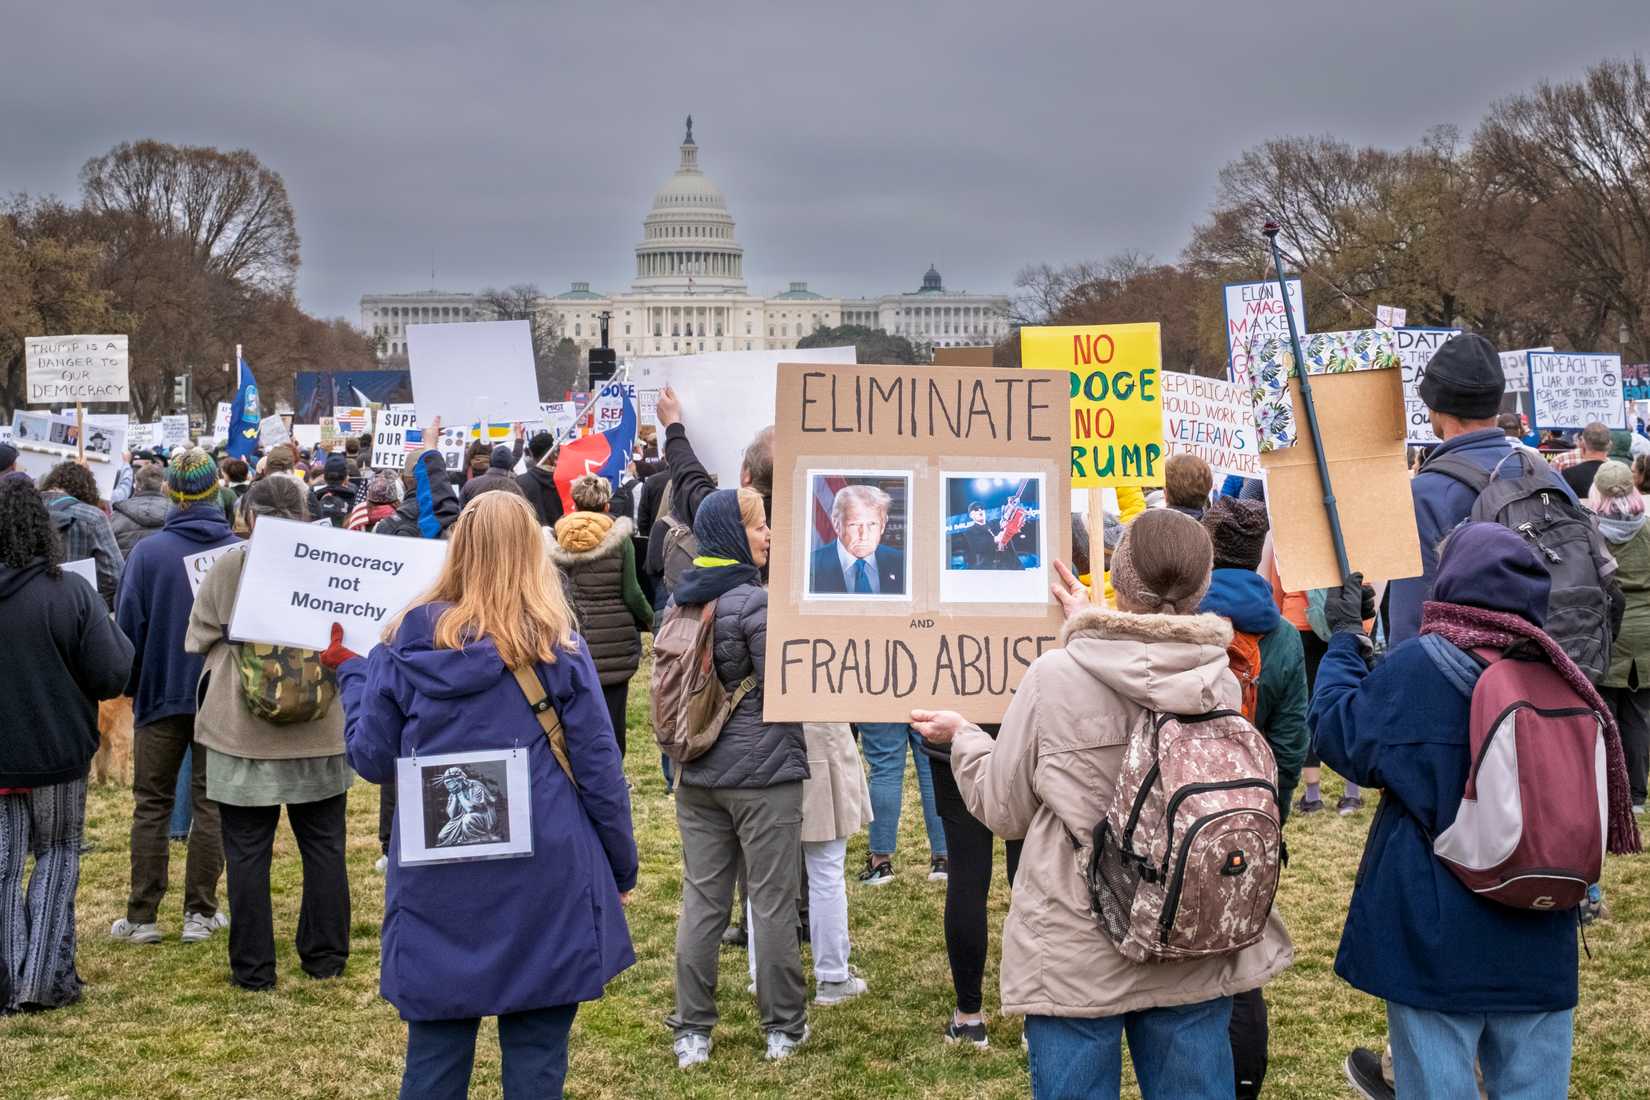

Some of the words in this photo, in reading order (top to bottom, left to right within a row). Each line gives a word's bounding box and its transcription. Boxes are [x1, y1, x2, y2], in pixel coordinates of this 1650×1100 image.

[1242, 285, 1274, 302] ELON
[86, 343, 98, 351] IS
[106, 342, 117, 351] A
[1073, 334, 1115, 366] NO
[38, 358, 93, 368] DANGER
[101, 358, 119, 367] TO
[1532, 355, 1587, 374] IMPEACH
[1591, 359, 1615, 374] THE
[62, 370, 90, 381] OUR
[1541, 376, 1563, 388] LIAR
[1566, 376, 1575, 386] IN
[33, 384, 124, 399] DEMOCRACY
[1536, 388, 1554, 400] FOR
[1595, 388, 1618, 398] TIME
[801, 372, 1052, 442] ELIMINATE
[1205, 404, 1237, 424] WORK
[385, 413, 416, 427] SUPP
[1075, 408, 1115, 439] NO
[1552, 413, 1580, 425] YOUR
[378, 432, 401, 445] OUR
[1170, 418, 1245, 449] VETERANS
[375, 452, 405, 466] VETE
[293, 542, 404, 576] Democracy
[328, 575, 361, 592] not
[290, 591, 387, 622] Monarchy
[909, 618, 935, 629] AND
[781, 638, 917, 698] FRAUD
